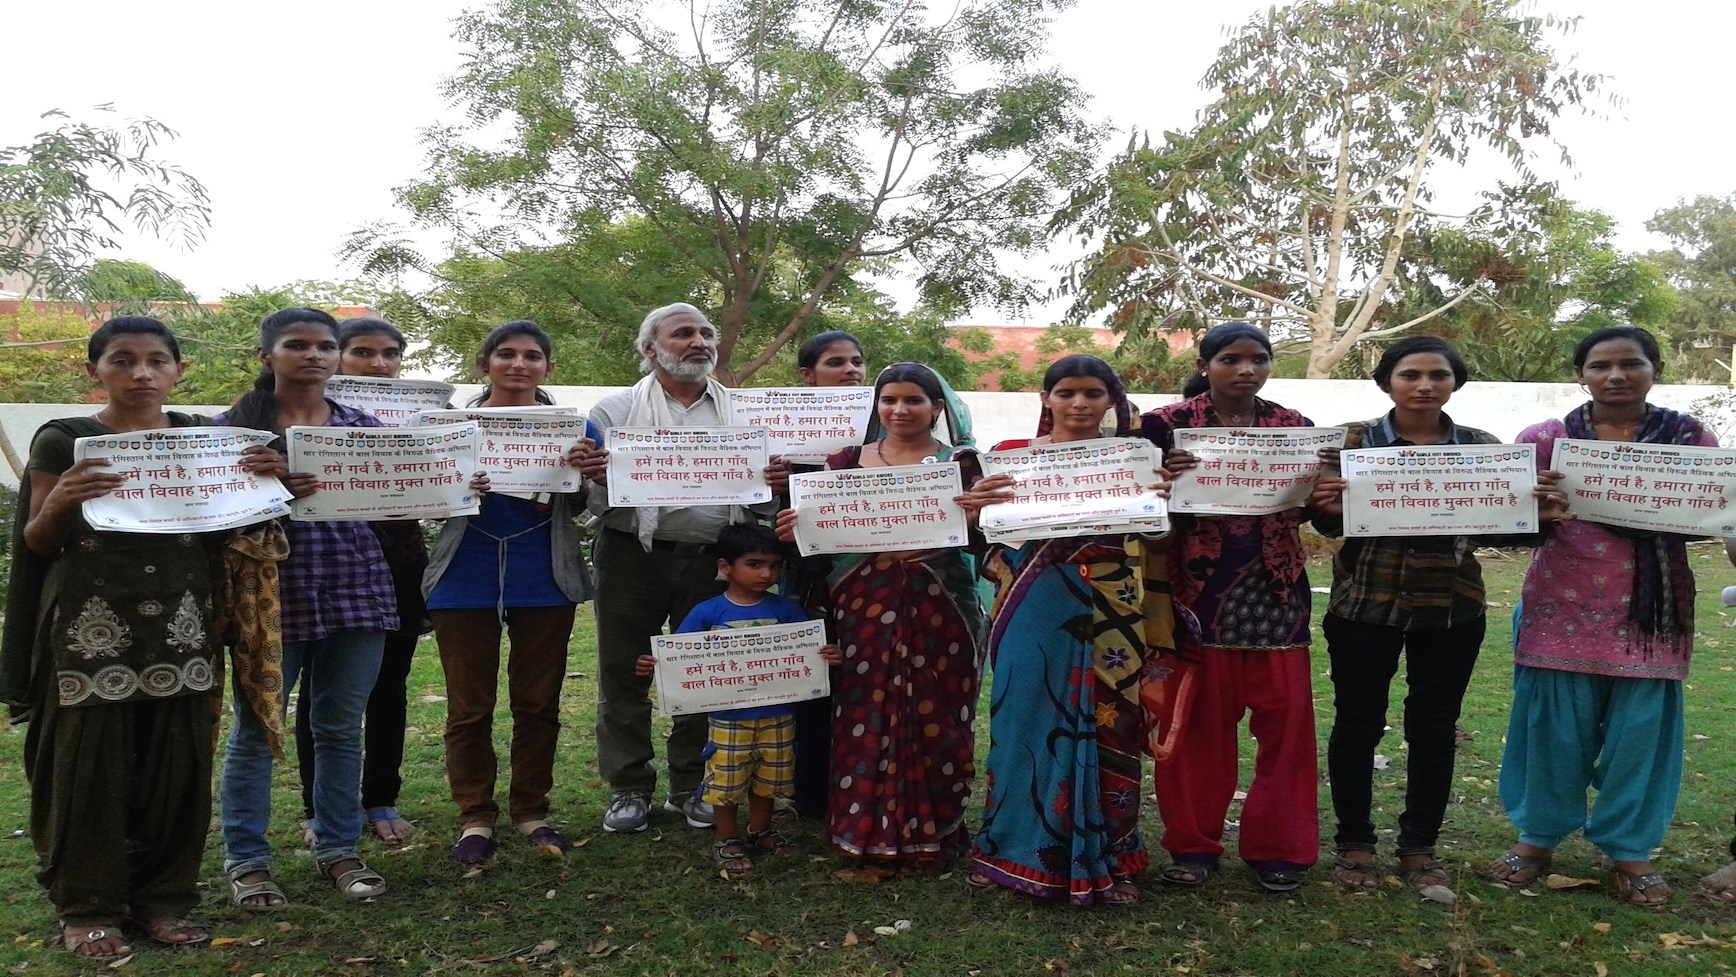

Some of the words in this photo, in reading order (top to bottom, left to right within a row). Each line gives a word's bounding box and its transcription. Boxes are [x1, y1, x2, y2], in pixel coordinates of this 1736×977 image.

[373, 409, 404, 418] हमारा
[765, 415, 779, 426] गर्व
[798, 430, 820, 441] मुक्त
[849, 427, 856, 438] है
[504, 444, 535, 453] हमारा
[323, 462, 343, 475] हमें
[348, 462, 369, 474] गर्व
[394, 463, 430, 472] हमारा
[504, 458, 529, 469] मुक्त
[635, 456, 652, 467] हमें
[656, 455, 673, 466] गर्व
[692, 457, 723, 466] हमारा
[1203, 459, 1222, 471] हमें
[1226, 458, 1247, 471] गर्व
[1269, 463, 1300, 472] हमारा
[146, 465, 170, 480] गर्व
[196, 466, 225, 478] हमारा
[631, 472, 652, 481] बाल
[656, 469, 690, 480] विवाह
[694, 472, 718, 483] मुक्त
[747, 469, 754, 480] है
[1032, 474, 1051, 487] गर्व
[1073, 473, 1107, 485] हमारा
[114, 488, 144, 499] बाल
[150, 484, 194, 497] विवाह
[199, 483, 222, 499] मुक्त
[249, 477, 258, 490] है
[350, 476, 390, 489] विवाह
[394, 477, 423, 491] मुक्त
[455, 471, 463, 483] है
[1196, 476, 1221, 486] बाल
[1226, 475, 1264, 486] विवाह
[1268, 479, 1292, 490] मुक्त
[1375, 480, 1394, 493] हमें
[1399, 480, 1419, 492] गर्व
[1442, 481, 1480, 492] हमारा
[1584, 473, 1603, 485] हमें
[1608, 475, 1630, 488] गर्व
[1654, 480, 1693, 492] हमारा
[1034, 489, 1071, 503] विवाह
[1075, 490, 1102, 502] मुक्त
[1133, 482, 1143, 496] है
[1575, 488, 1600, 500] बाल
[1607, 490, 1646, 504] विवाह
[1651, 496, 1681, 508] मुक्त
[1718, 498, 1728, 509] है
[819, 503, 836, 515] हमें
[840, 501, 858, 512] गर्व
[879, 499, 912, 510] हमारा
[1370, 499, 1396, 509] बाल
[1401, 496, 1440, 508] विवाह
[1444, 497, 1473, 510] मुक्त
[1508, 493, 1518, 506] है
[815, 519, 838, 529] बाल
[842, 515, 878, 527] विवाह
[882, 516, 908, 528] मुक्त
[938, 509, 947, 522] है
[685, 663, 702, 676] हमें
[706, 662, 725, 673] गर्व
[745, 658, 779, 669] हमारा
[681, 680, 705, 690] बाल
[709, 675, 744, 688] विवाह
[748, 675, 774, 687] मुक्त
[803, 666, 812, 677] है
